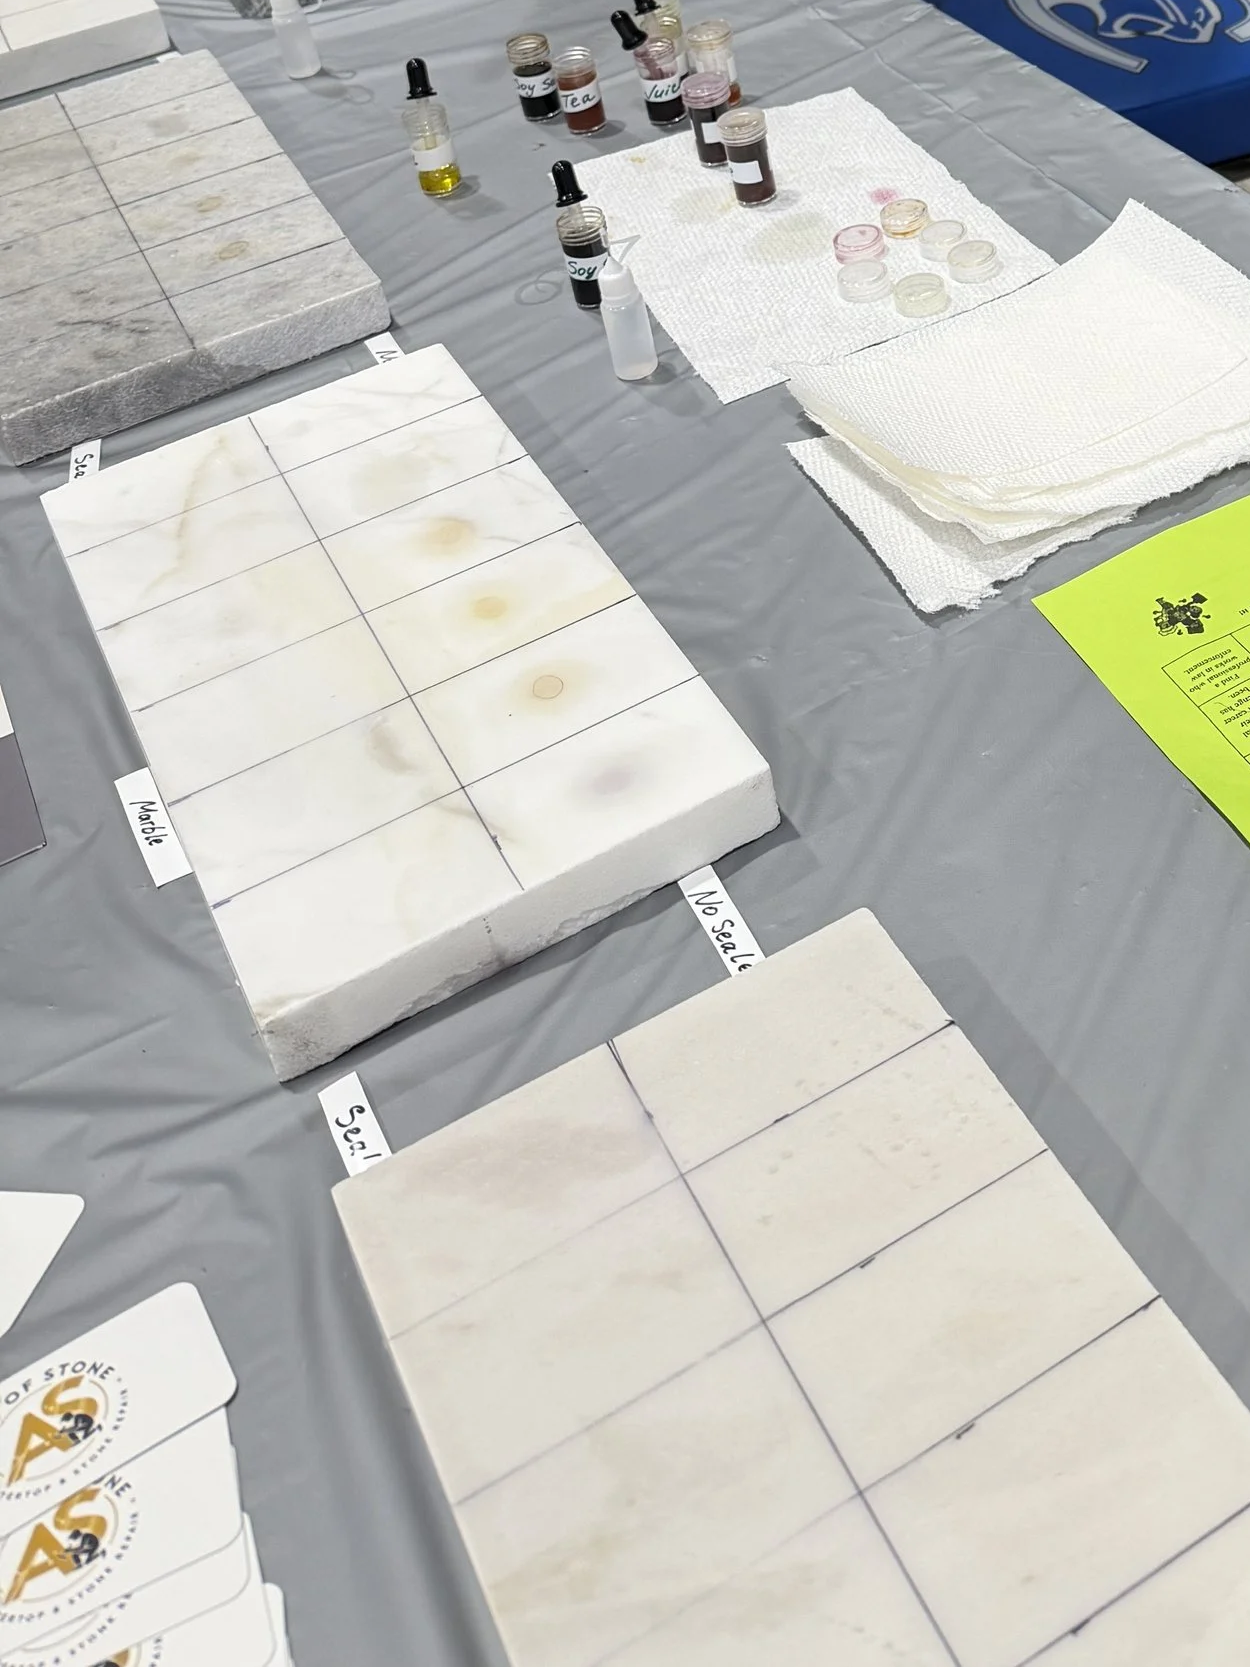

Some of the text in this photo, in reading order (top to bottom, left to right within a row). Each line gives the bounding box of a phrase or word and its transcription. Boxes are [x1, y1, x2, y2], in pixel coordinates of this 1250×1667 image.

[561, 92, 596, 108] Tea
[567, 260, 598, 280] Soy
[1184, 649, 1231, 674] enforcement.
[1215, 656, 1238, 668] works
[1190, 657, 1250, 692] professional who
[1192, 672, 1205, 681] law
[1221, 674, 1240, 685] Find
[1228, 687, 1250, 698] been.
[1220, 706, 1235, 715] has
[1224, 710, 1247, 724] career
[129, 801, 169, 847] Marble
[687, 890, 724, 916] No
[4, 1360, 116, 1405] OF STONE
